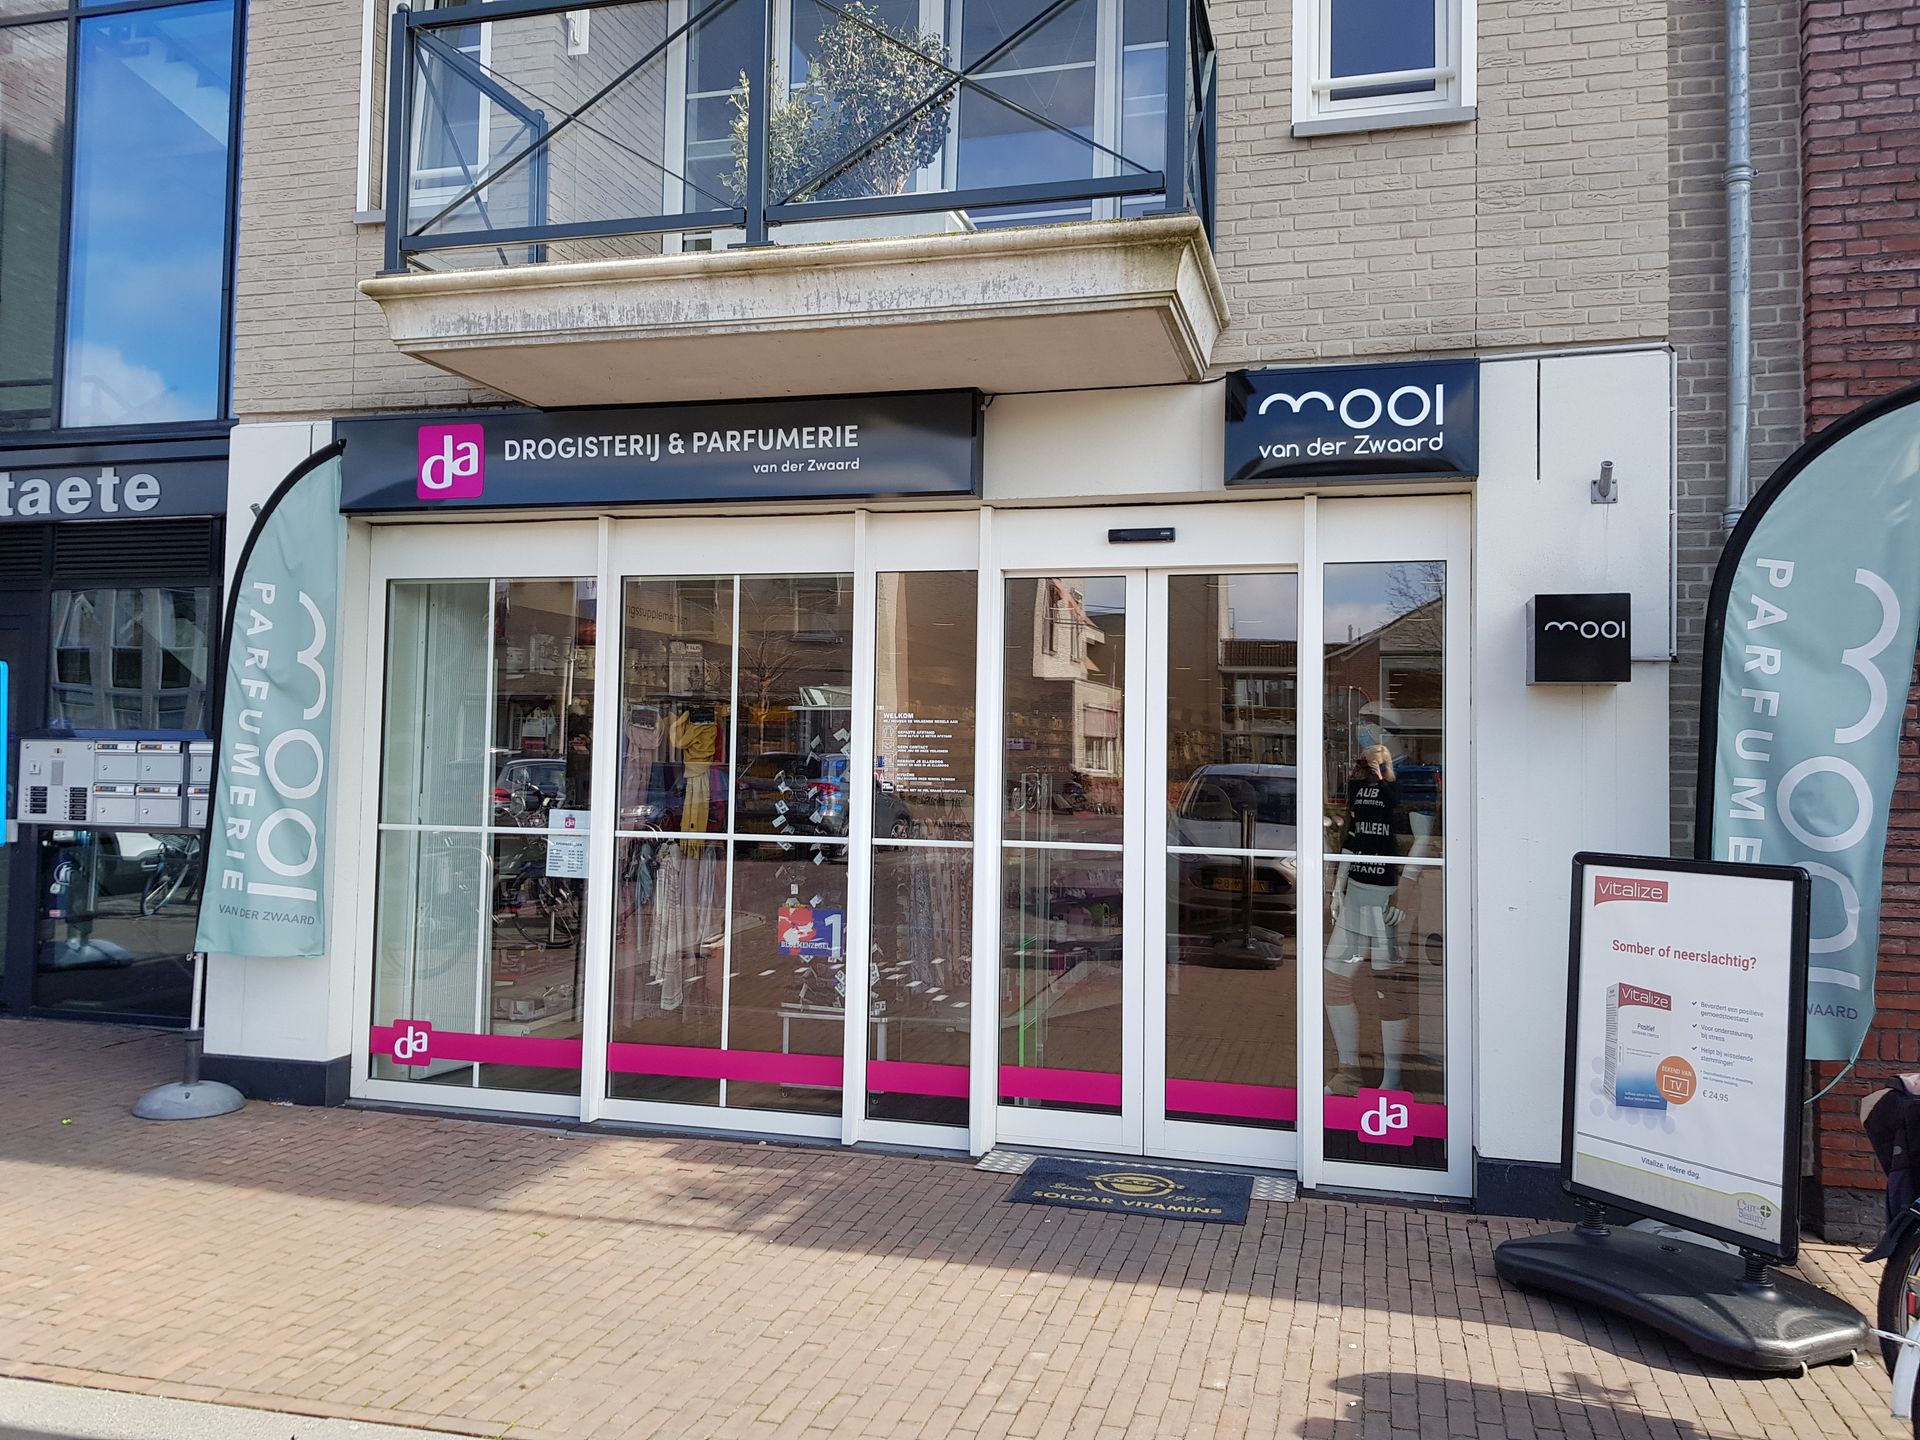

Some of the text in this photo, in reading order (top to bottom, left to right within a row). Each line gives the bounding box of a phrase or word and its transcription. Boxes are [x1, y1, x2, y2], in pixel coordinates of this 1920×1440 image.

[504, 424, 859, 462] DROGISTERIJ & PARFUMERIE
[1258, 431, 1444, 458] van der Zwaard
[421, 434, 479, 490] da
[753, 457, 860, 473] van der Zwaard
[883, 712, 914, 720] WELKOM
[1727, 558, 1796, 864] PARFUME
[220, 581, 278, 892] PARFUMERIE
[1356, 787, 1380, 798] AUB
[218, 903, 315, 926] VAN DER ZWAARD
[1612, 939, 1757, 972] Somber of neerslachtig?
[1808, 1003, 1858, 1020] AARD
[1700, 1024, 1713, 1032] Voor
[394, 1025, 429, 1059] da
[1670, 1079, 1683, 1091] TV
[1708, 1090, 1729, 1102] 24,95
[1360, 1096, 1408, 1136] da
[1031, 1190, 1114, 1206] SOLGAR
[1122, 1200, 1223, 1215] VITAMINS
